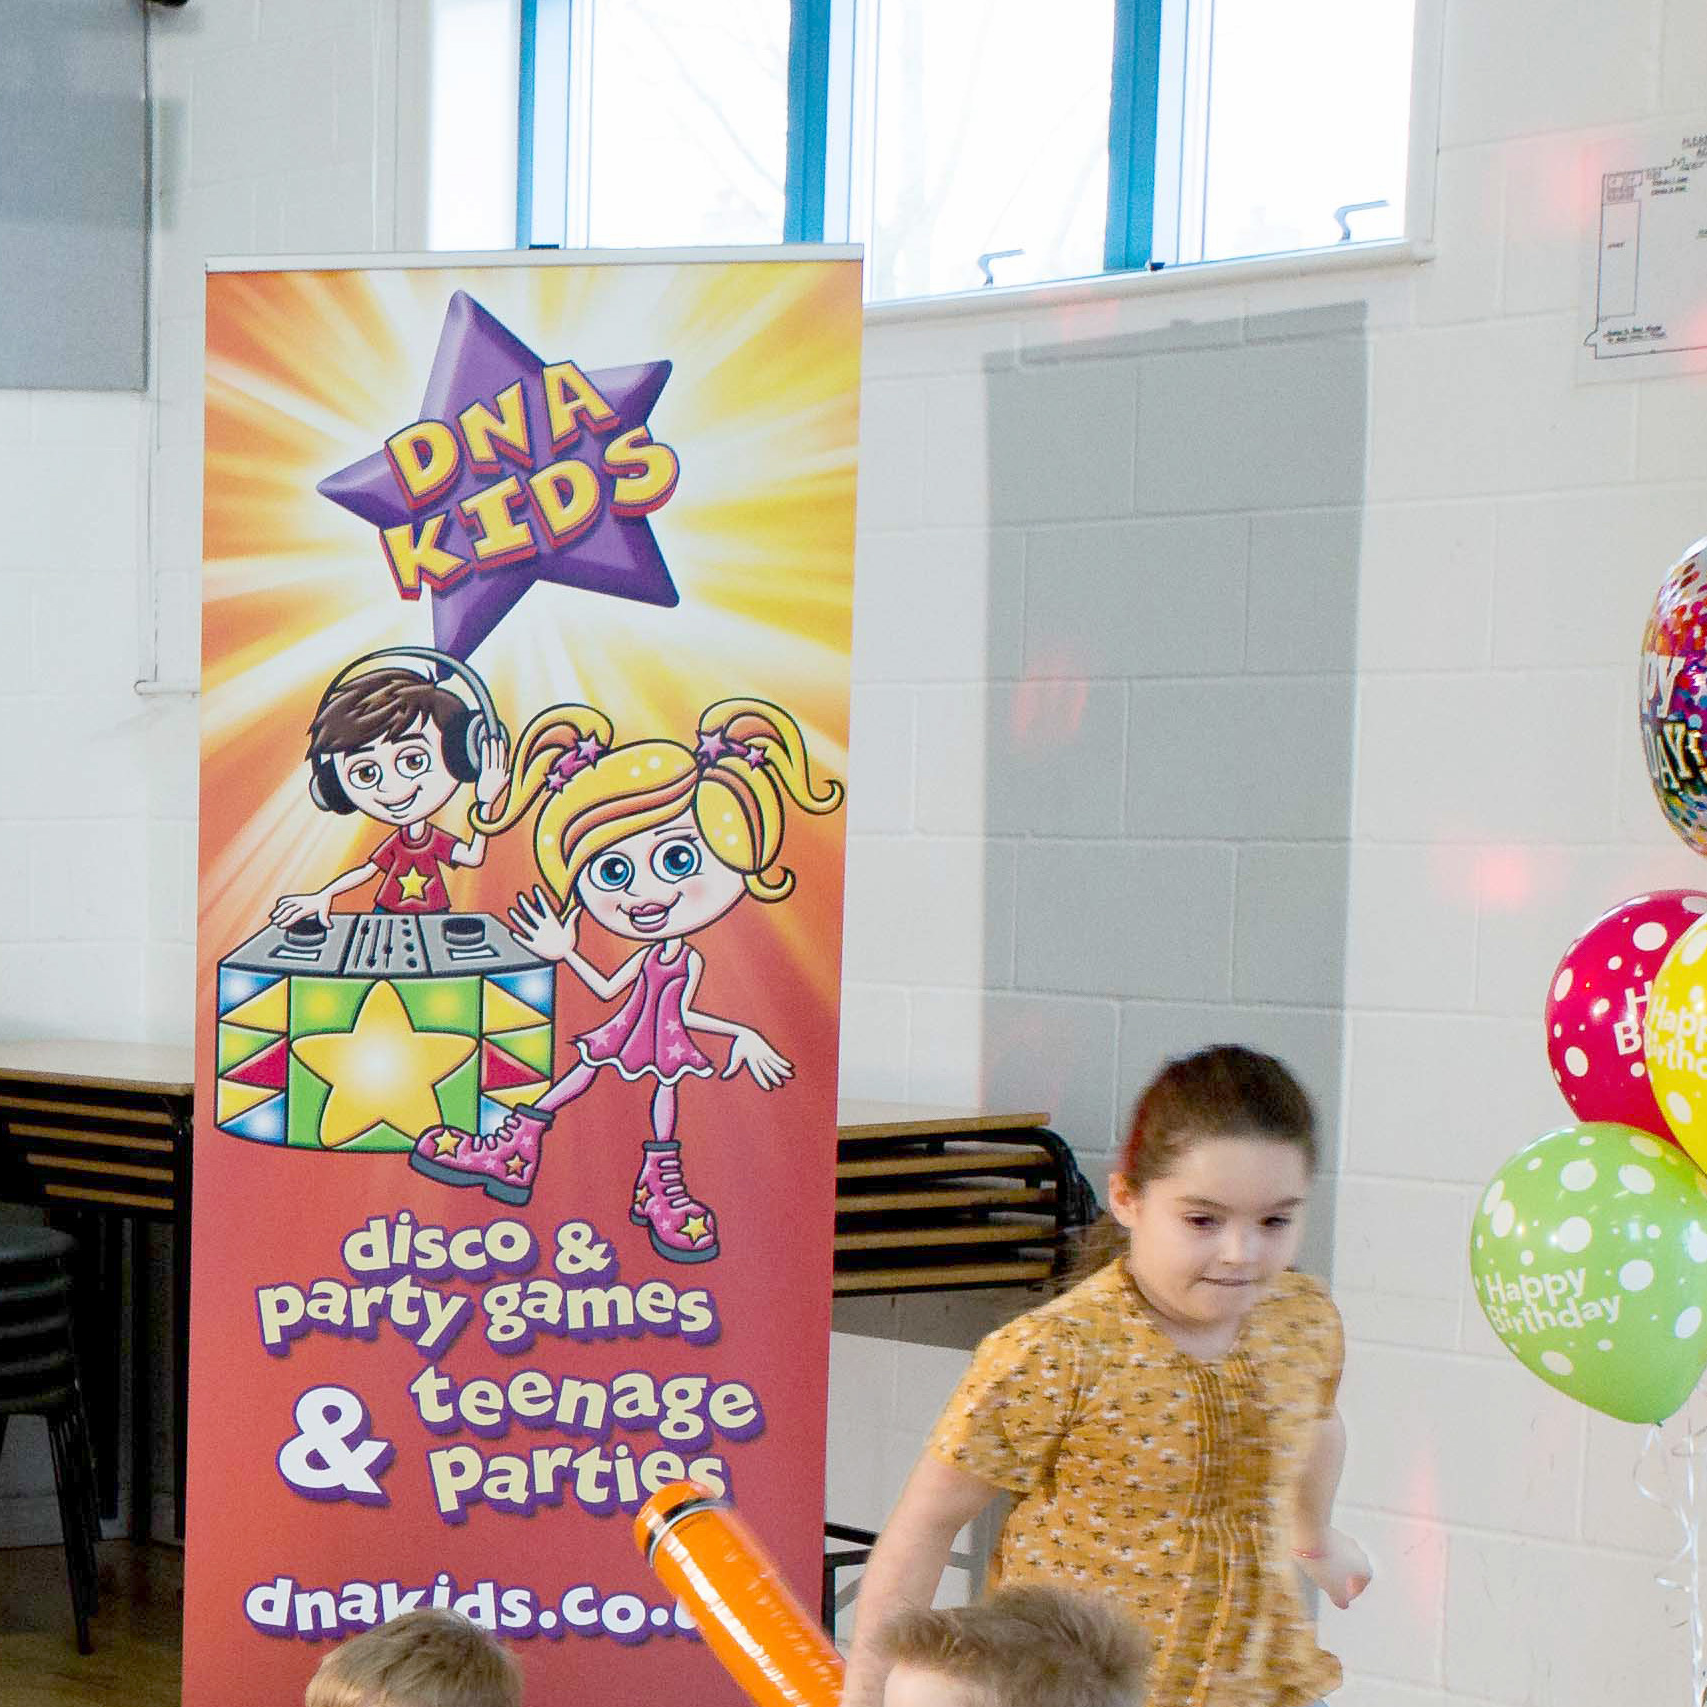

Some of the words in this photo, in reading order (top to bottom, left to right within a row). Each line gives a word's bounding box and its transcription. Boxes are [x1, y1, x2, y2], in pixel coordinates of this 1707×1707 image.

[384, 360, 619, 511] DNA
[379, 424, 681, 601] KIDS
[343, 1211, 533, 1274] disco
[555, 1221, 615, 1276] &
[257, 1276, 467, 1348] party
[483, 1279, 715, 1345] games
[1483, 1266, 1587, 1308] Happy
[1487, 1294, 1622, 1335] Birthday
[410, 1366, 759, 1442] teenage
[278, 1386, 389, 1496] &
[428, 1446, 727, 1514] parties
